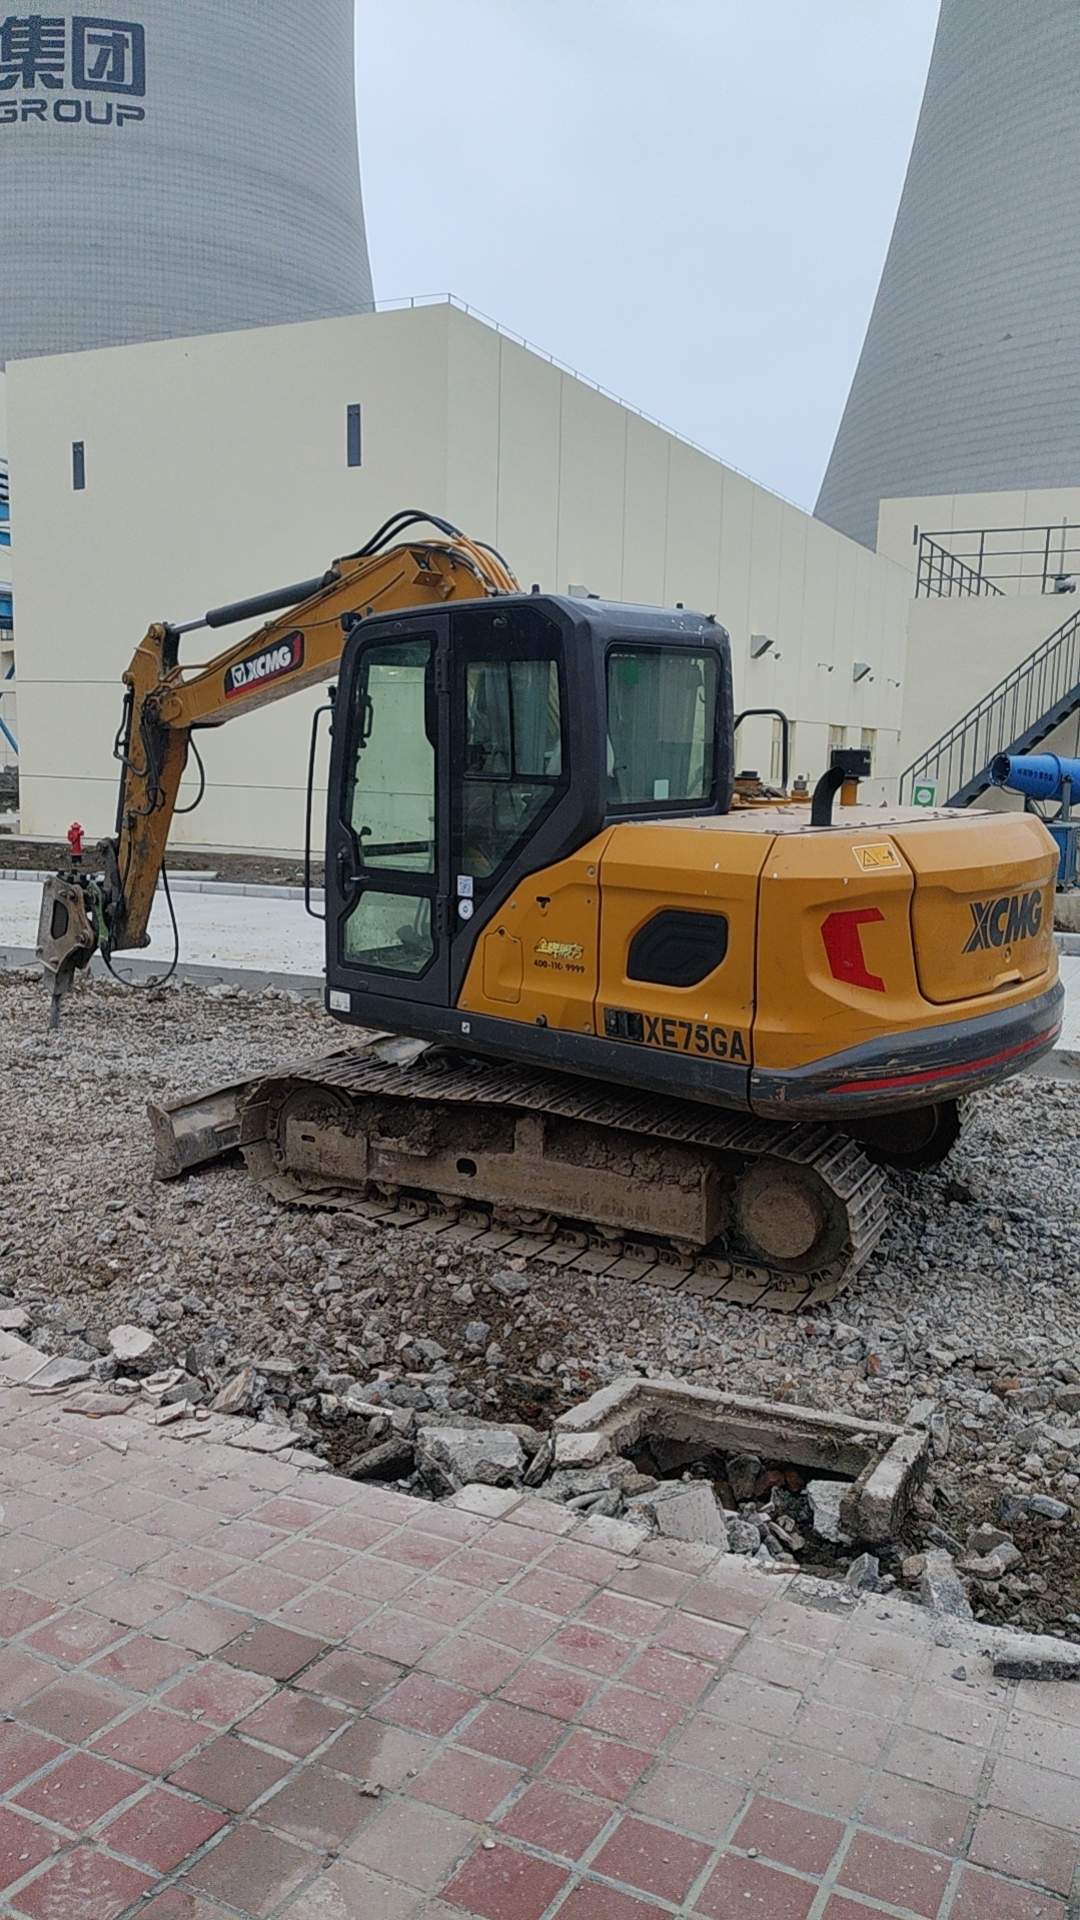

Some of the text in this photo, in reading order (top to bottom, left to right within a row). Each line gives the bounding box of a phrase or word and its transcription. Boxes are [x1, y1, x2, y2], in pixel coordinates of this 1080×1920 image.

[0, 15, 146, 97] 集团
[0, 98, 146, 126] GROUP
[245, 645, 292, 681] XCMG
[961, 889, 1042, 954] XCMG
[644, 1013, 748, 1061] XE75GA
